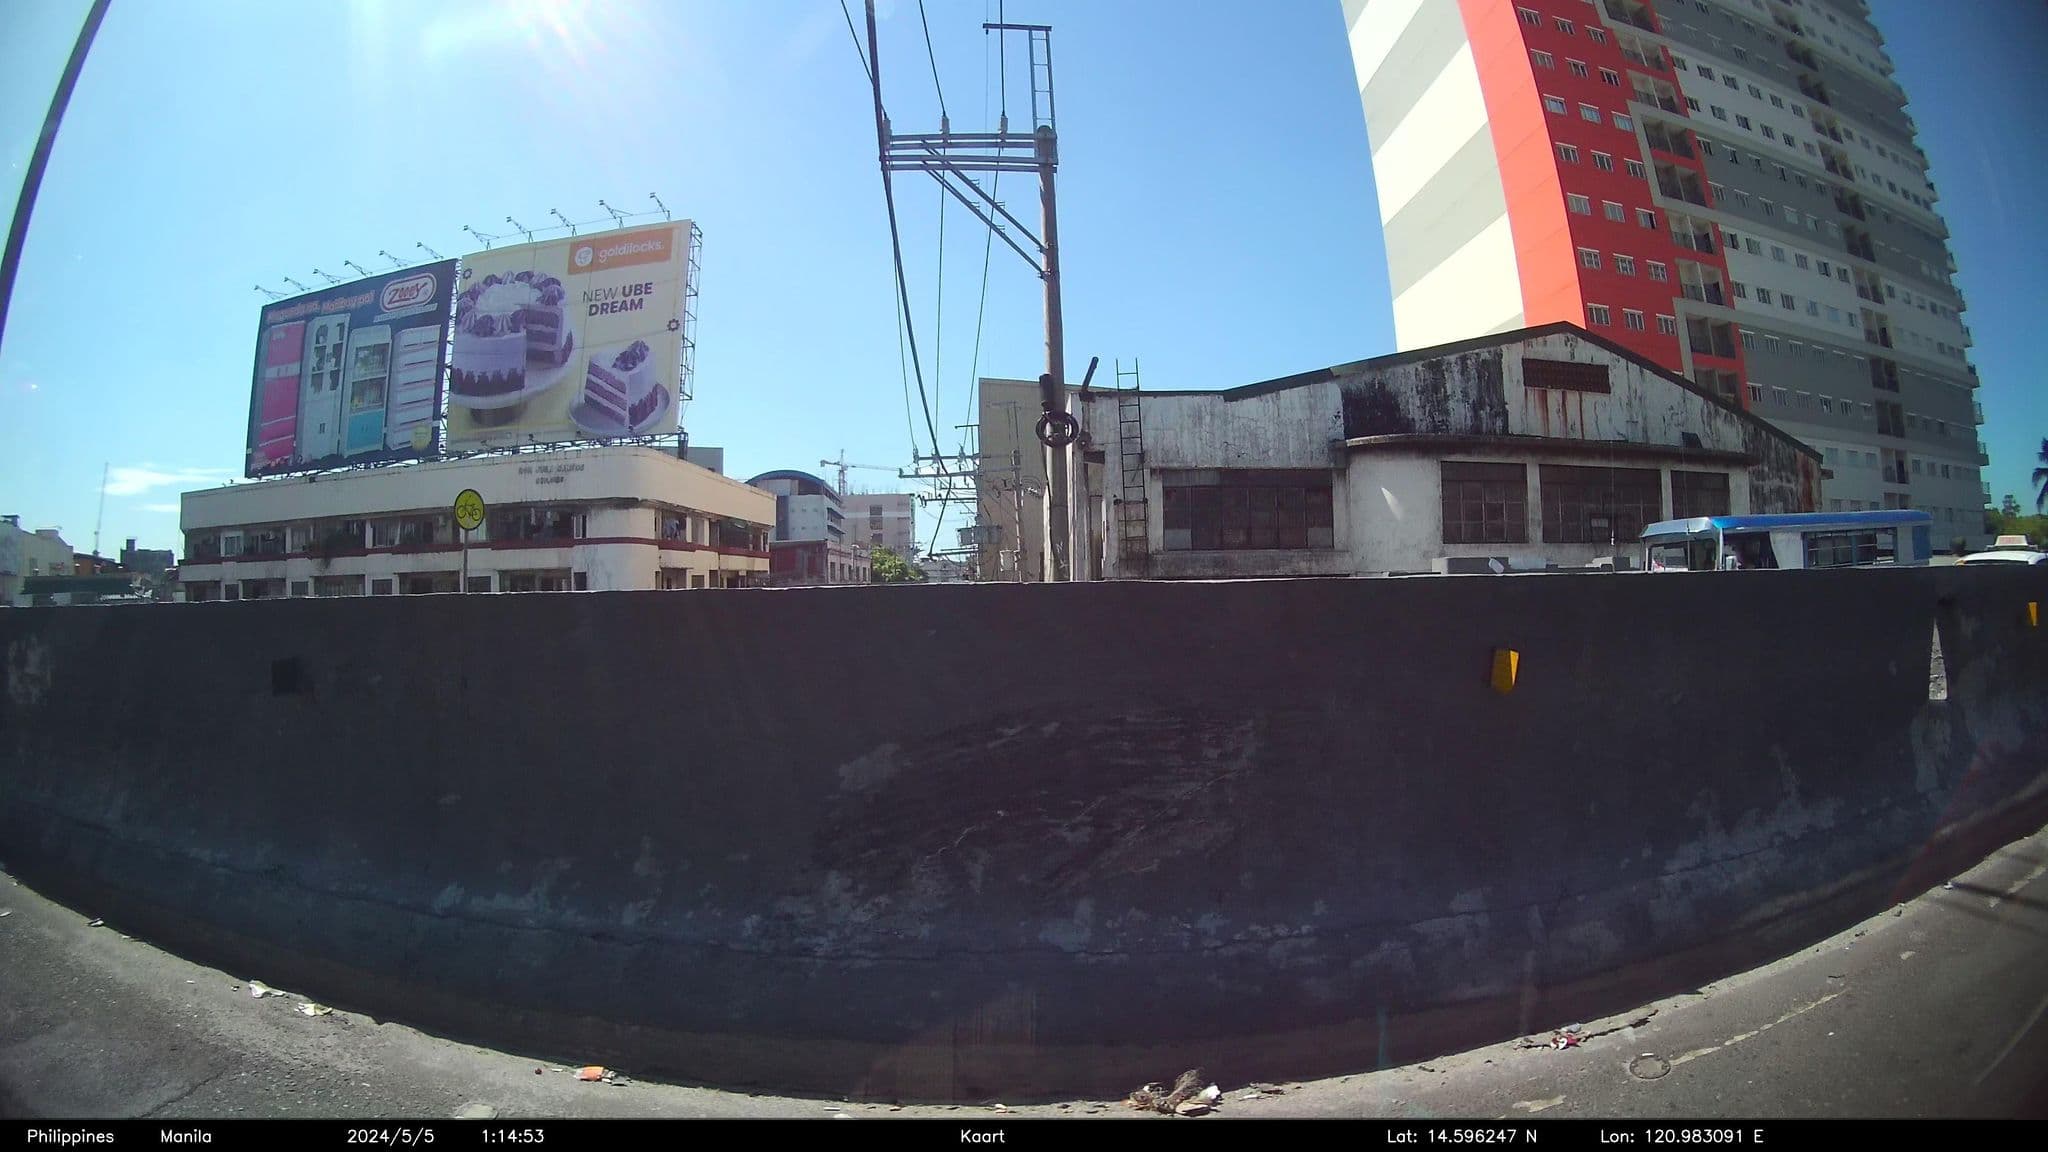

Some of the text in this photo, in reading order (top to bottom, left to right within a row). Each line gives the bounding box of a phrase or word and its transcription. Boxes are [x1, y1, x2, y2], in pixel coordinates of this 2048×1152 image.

[583, 282, 654, 304] NEW UBE
[588, 298, 644, 317] DREAM
